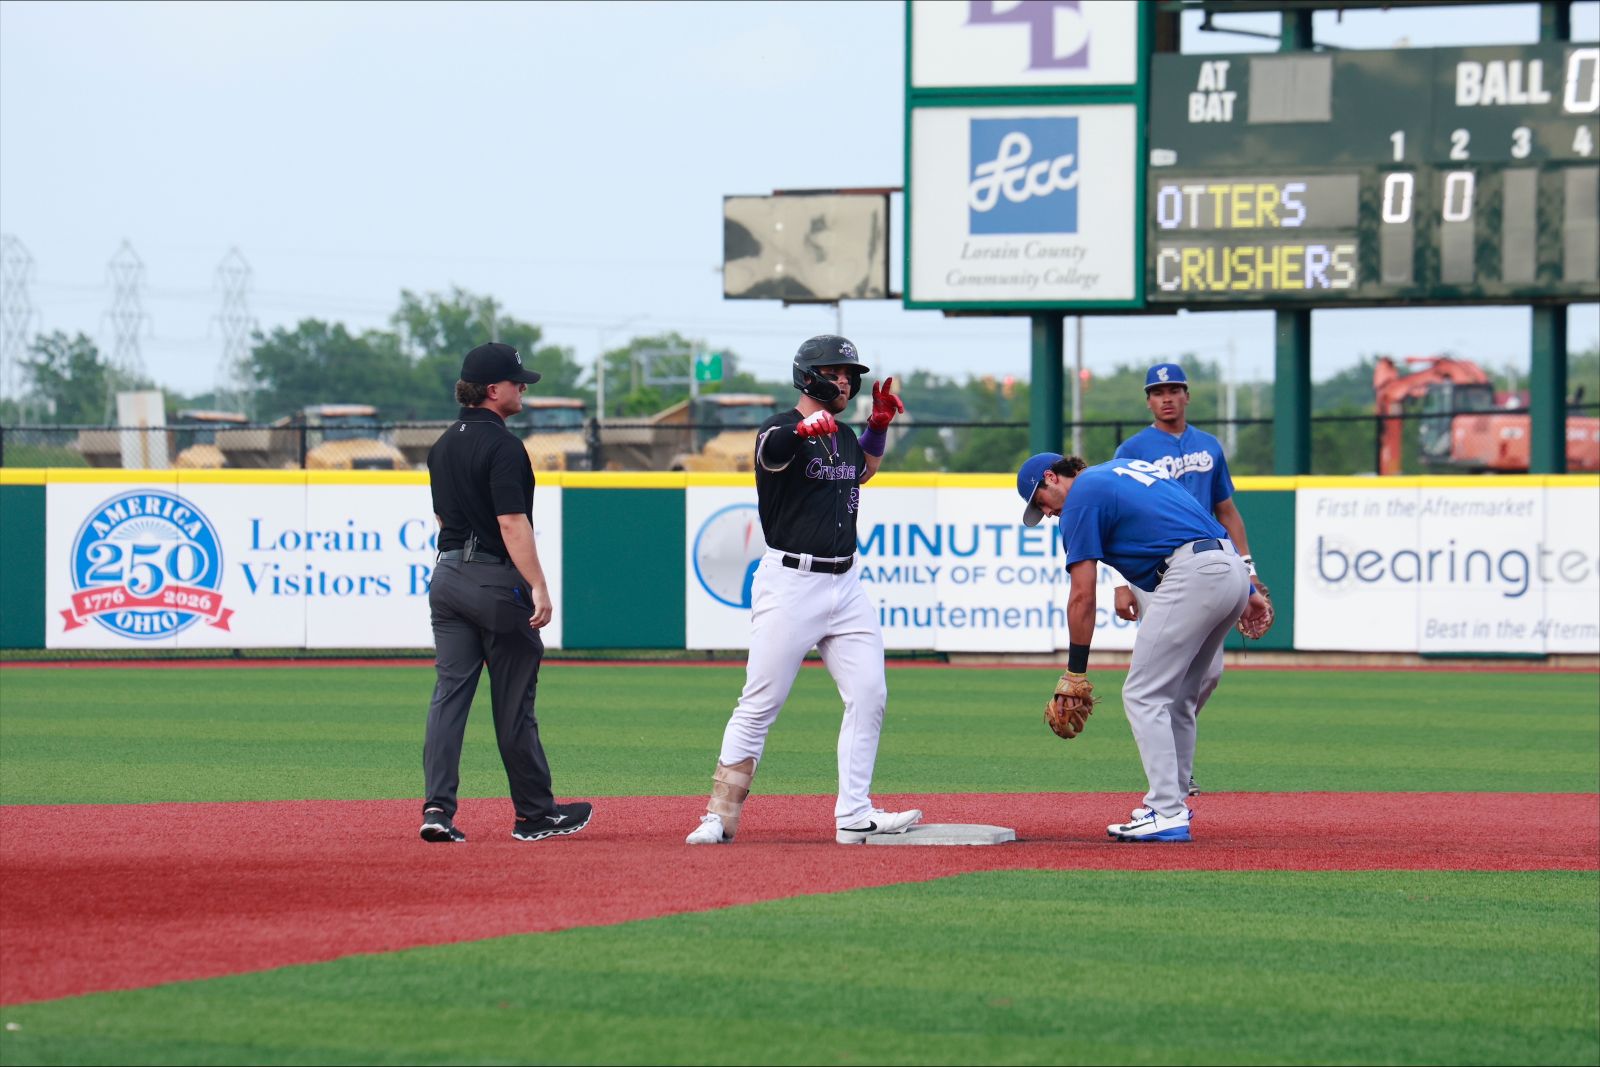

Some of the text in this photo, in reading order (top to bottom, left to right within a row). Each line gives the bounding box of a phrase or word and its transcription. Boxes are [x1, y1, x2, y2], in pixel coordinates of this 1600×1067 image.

[1198, 61, 1230, 91] AT
[1455, 60, 1551, 107] BALL
[1563, 48, 1599, 113] 0
[1188, 92, 1237, 123] BAT
[1390, 125, 1593, 162] 1 2 3 4
[1156, 183, 1307, 229] OTTERS
[1382, 171, 1475, 224] 0 0
[960, 240, 1087, 264] Lorain County
[1156, 245, 1356, 291] CRUSHERS
[945, 267, 1100, 290] Community College
[90, 494, 204, 539] AMERICA
[1315, 497, 1536, 519] First in the Aftermarket
[249, 518, 384, 552] Lorain
[857, 523, 1065, 558] MINUTE
[87, 541, 208, 596] 250
[239, 562, 392, 597] Visitors
[859, 566, 942, 585] AMILY
[950, 565, 987, 586] OF
[1316, 534, 1599, 598] bearingte
[83, 588, 213, 611] 1776 2026
[115, 611, 179, 633] OHIO
[1425, 619, 1599, 640] Best in the Afterm
